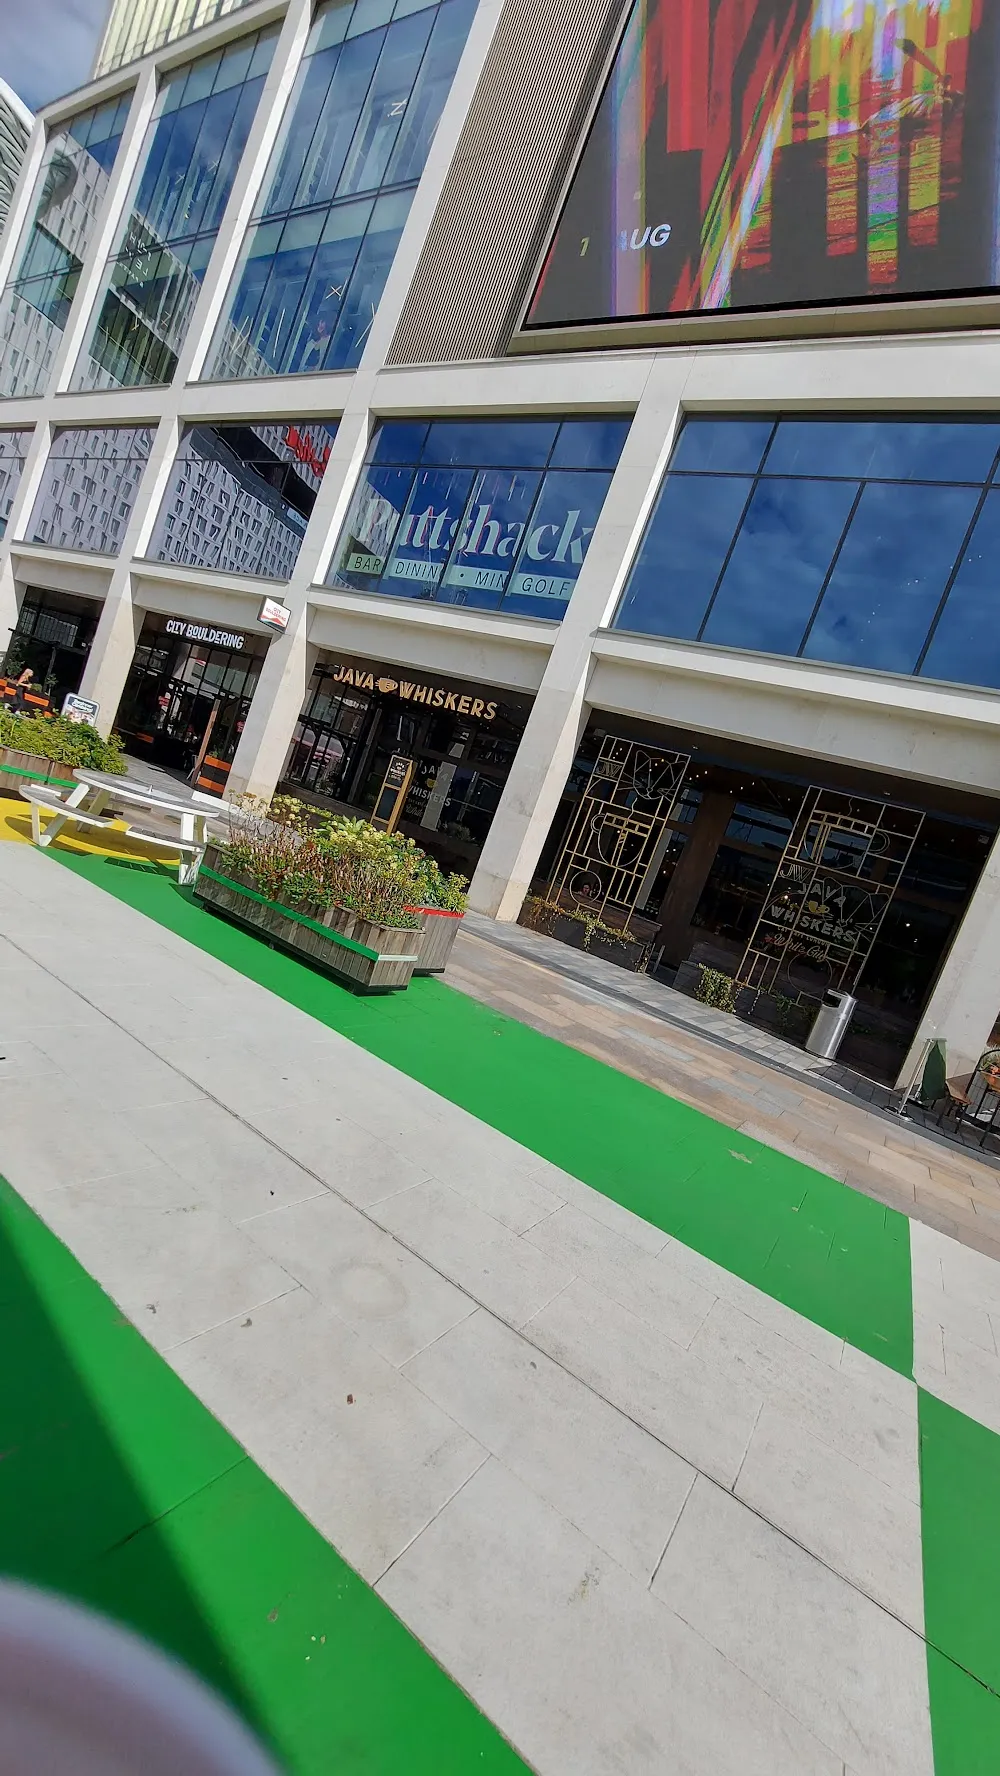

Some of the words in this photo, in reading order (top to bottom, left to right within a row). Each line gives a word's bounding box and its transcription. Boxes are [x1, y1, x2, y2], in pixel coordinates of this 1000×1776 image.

[357, 498, 594, 564] Puttshack
[354, 556, 381, 573] BAR
[521, 577, 571, 597] GOLF
[165, 619, 186, 636] CITY
[185, 623, 245, 650] BOULDERING
[333, 666, 374, 690] JAVA
[399, 680, 499, 721] WHISKERS
[797, 882, 847, 907] JAVA
